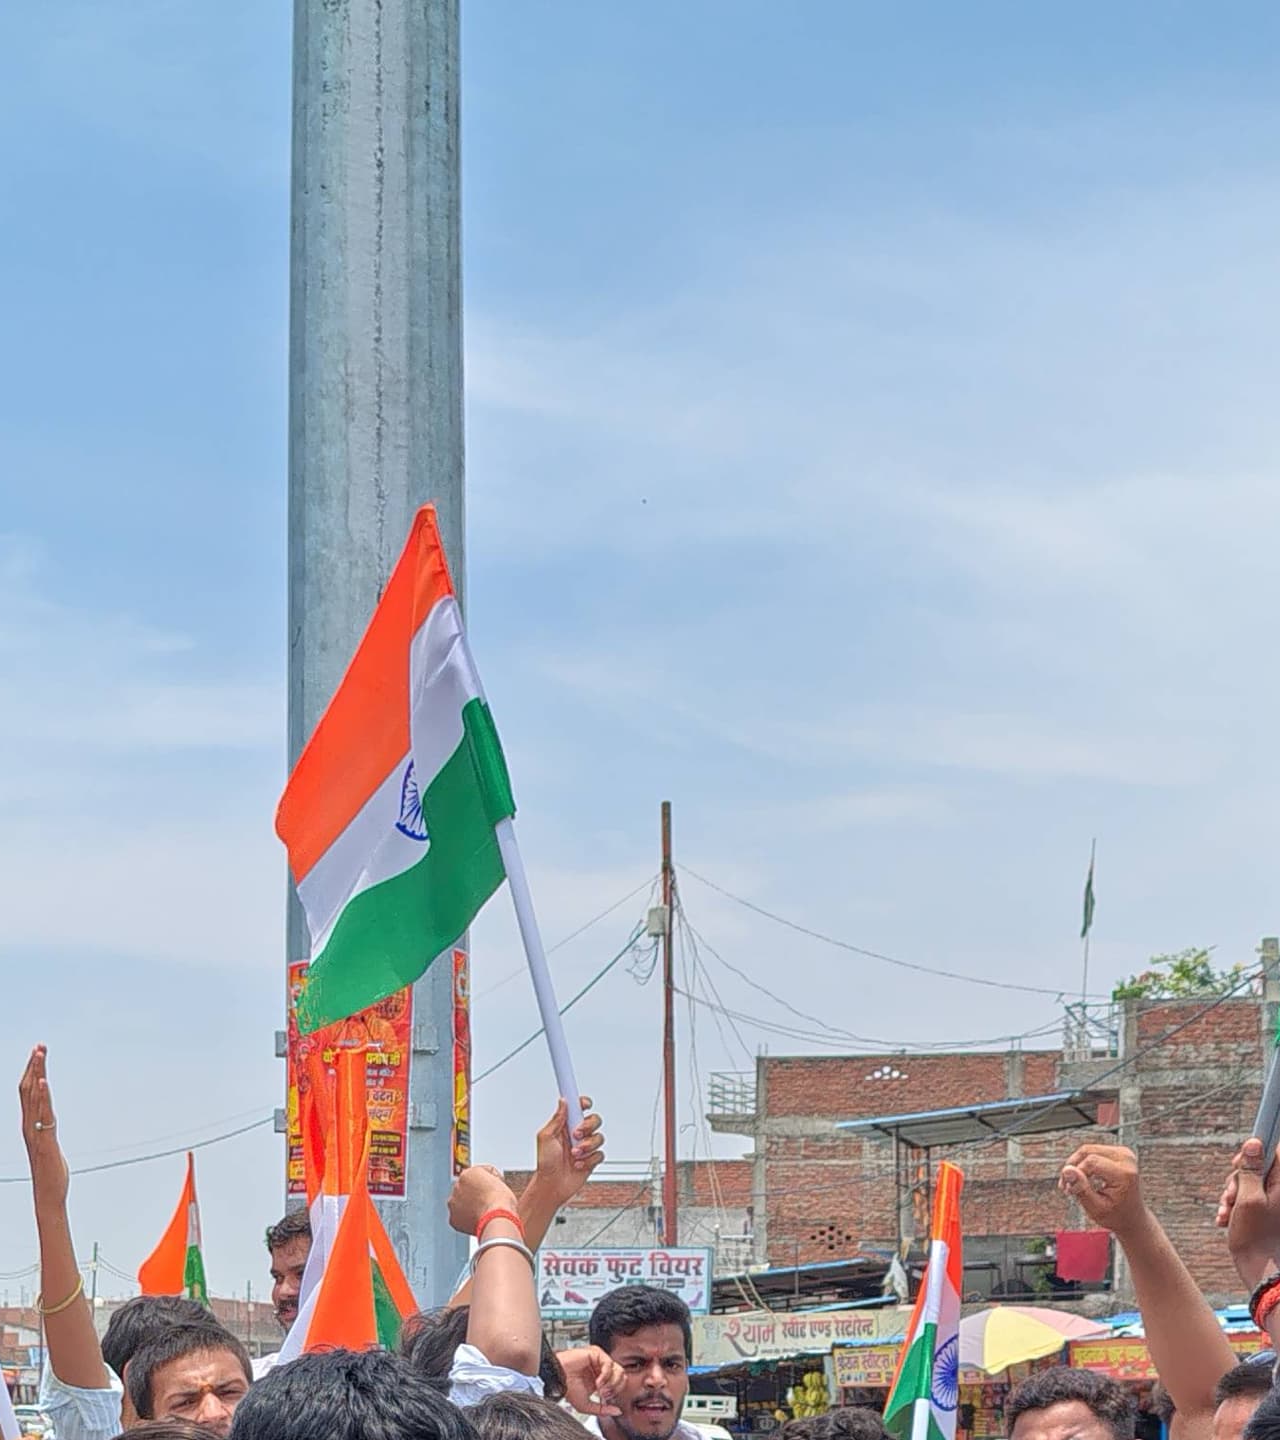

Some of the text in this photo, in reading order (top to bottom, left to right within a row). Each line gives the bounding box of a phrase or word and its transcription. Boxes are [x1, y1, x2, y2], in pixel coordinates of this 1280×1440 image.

[542, 1251, 705, 1284] सेवक फुट वियर
[809, 1320, 832, 1338] एण्ड
